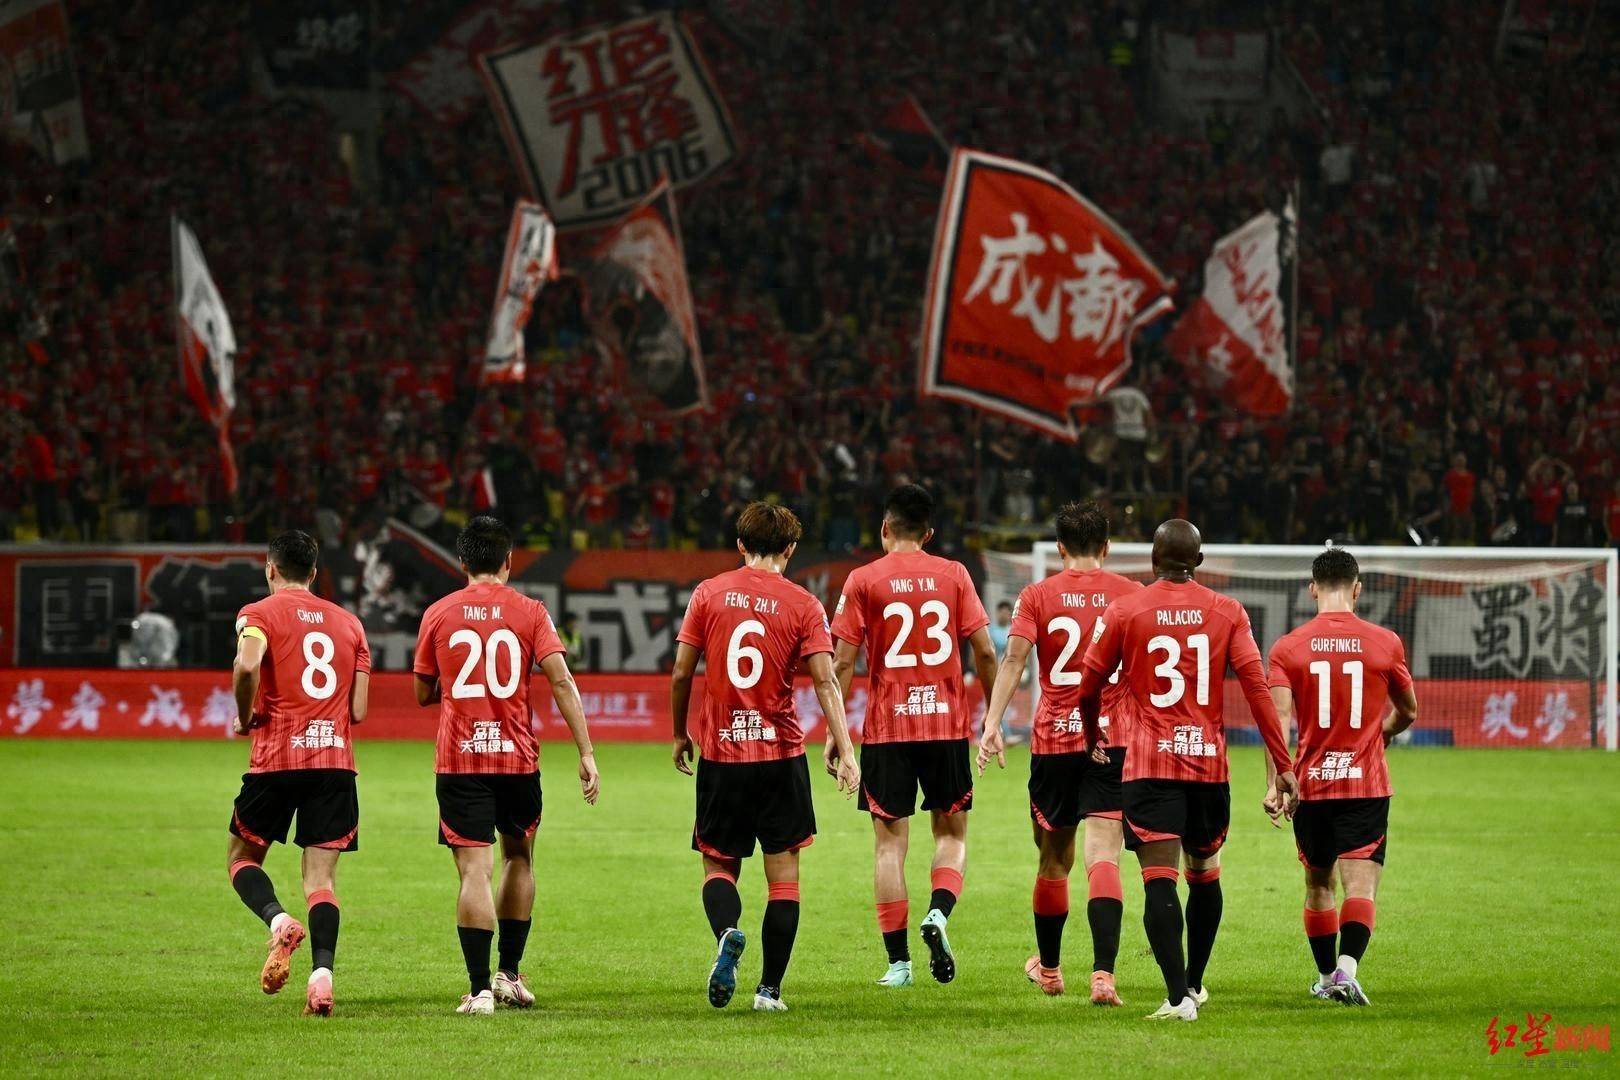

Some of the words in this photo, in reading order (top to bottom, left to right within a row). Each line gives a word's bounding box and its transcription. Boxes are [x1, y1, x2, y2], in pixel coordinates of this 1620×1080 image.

[962, 211, 1148, 358] 成都
[889, 578, 914, 593] YANG
[918, 577, 938, 592] Y.M.
[725, 592, 750, 609] FENG
[754, 597, 780, 615] ZH.Y.
[1061, 593, 1086, 607] TANG
[1092, 593, 1109, 607] CH.
[297, 608, 324, 624] CHOW
[463, 605, 487, 620] TANG
[492, 605, 504, 620] M.
[1156, 609, 1203, 625] PALACIOS
[883, 599, 953, 669] 23
[1311, 637, 1363, 653] GURFINKEL
[727, 619, 766, 690] 6
[301, 631, 338, 700] 8
[448, 628, 522, 700] 20
[1147, 633, 1210, 708] 31
[907, 691, 937, 704] 品胜
[1309, 660, 1364, 729] 11
[731, 716, 762, 728] 品胜
[305, 725, 335, 737] 品胜
[472, 727, 501, 740] 品胜
[1173, 731, 1204, 744] 品胜
[1321, 757, 1354, 769] 品胜
